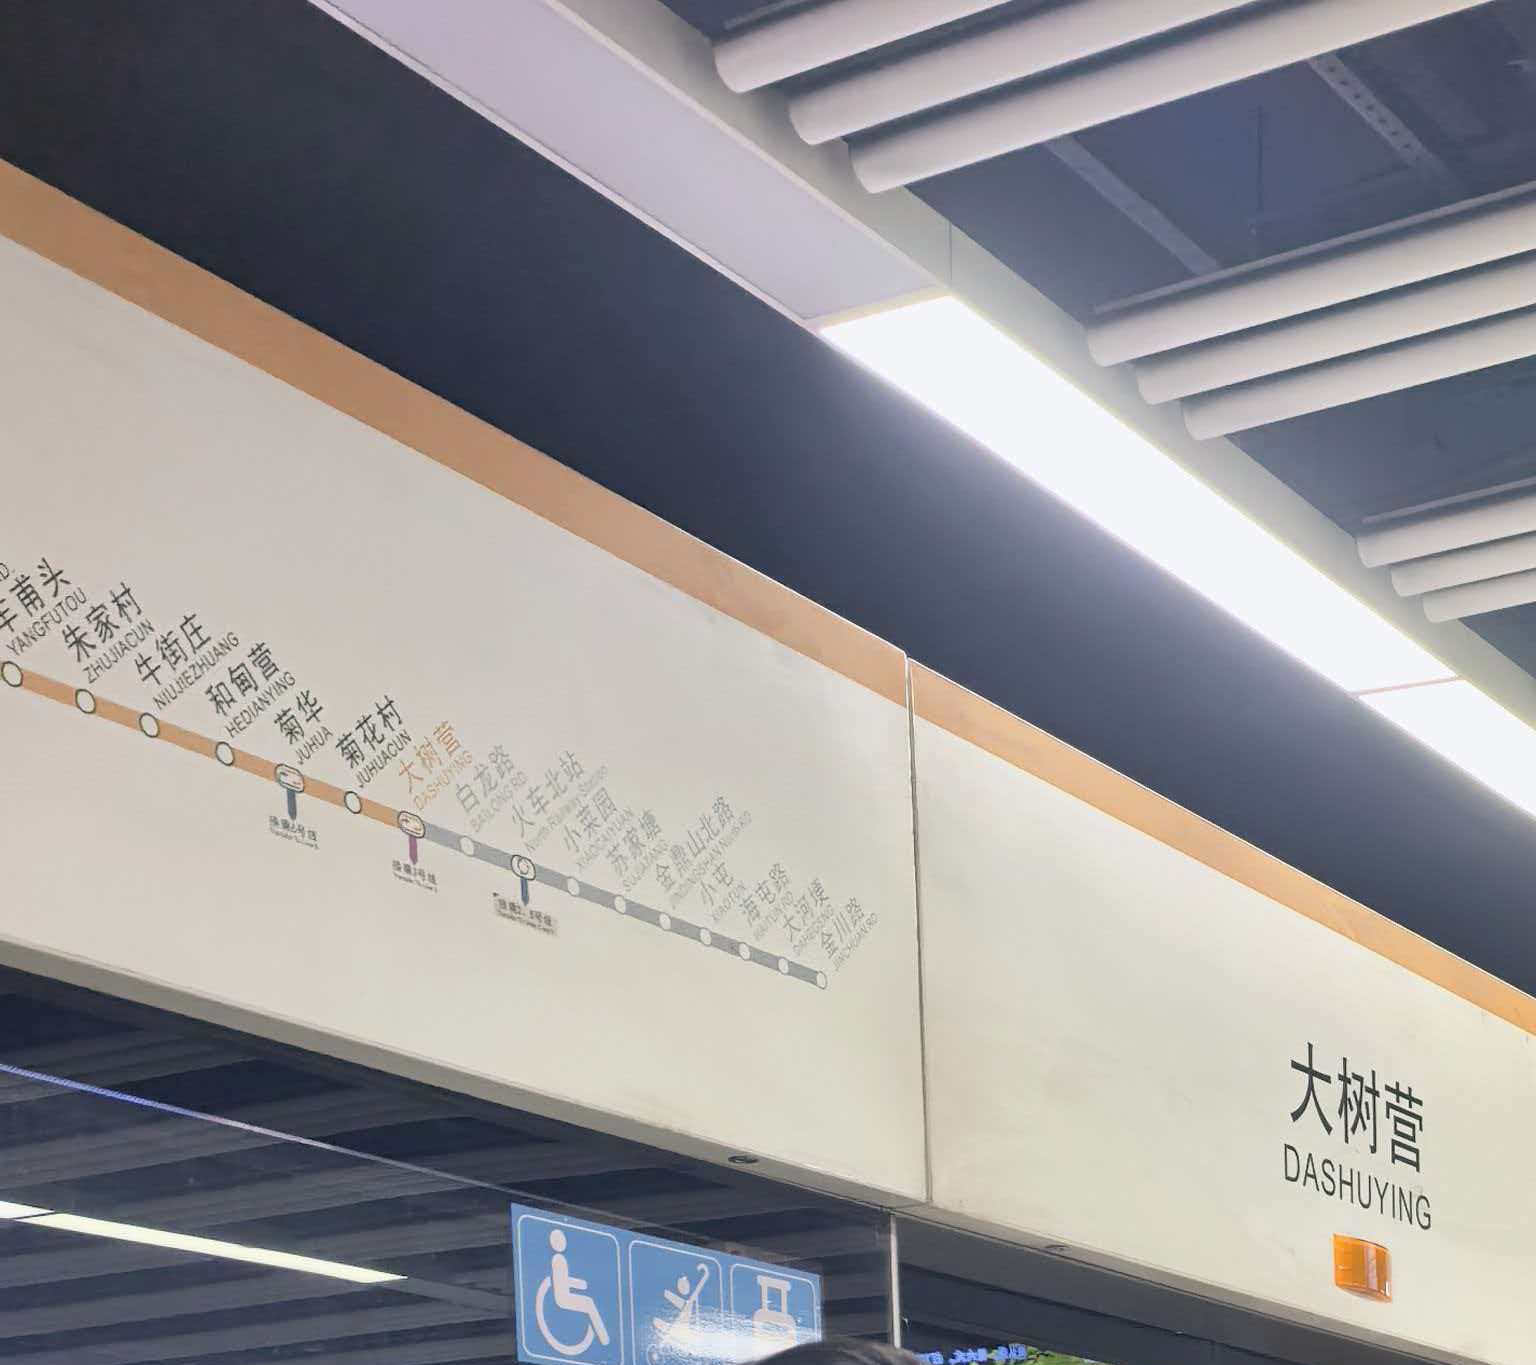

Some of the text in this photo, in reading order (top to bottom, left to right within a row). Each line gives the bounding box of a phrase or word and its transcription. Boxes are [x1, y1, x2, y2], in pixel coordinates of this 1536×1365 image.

[6, 587, 87, 656] YANGFUTOU
[62, 581, 142, 662] 朱家村
[82, 618, 156, 684] ZHUJIACUN
[134, 613, 211, 686] 牛街庄
[152, 631, 240, 711] NIUJIEZHUANG
[205, 641, 280, 716] 和甸营
[225, 671, 297, 739] HEDIANYING
[274, 689, 323, 745] 菊华
[295, 725, 334, 765] JUHUA
[335, 695, 403, 768] 菊花村
[355, 729, 412, 788] JUHUACUN
[399, 720, 461, 795] 大树营
[1290, 1042, 1424, 1173] 大树营
[1283, 1142, 1432, 1231] DASHUYING
